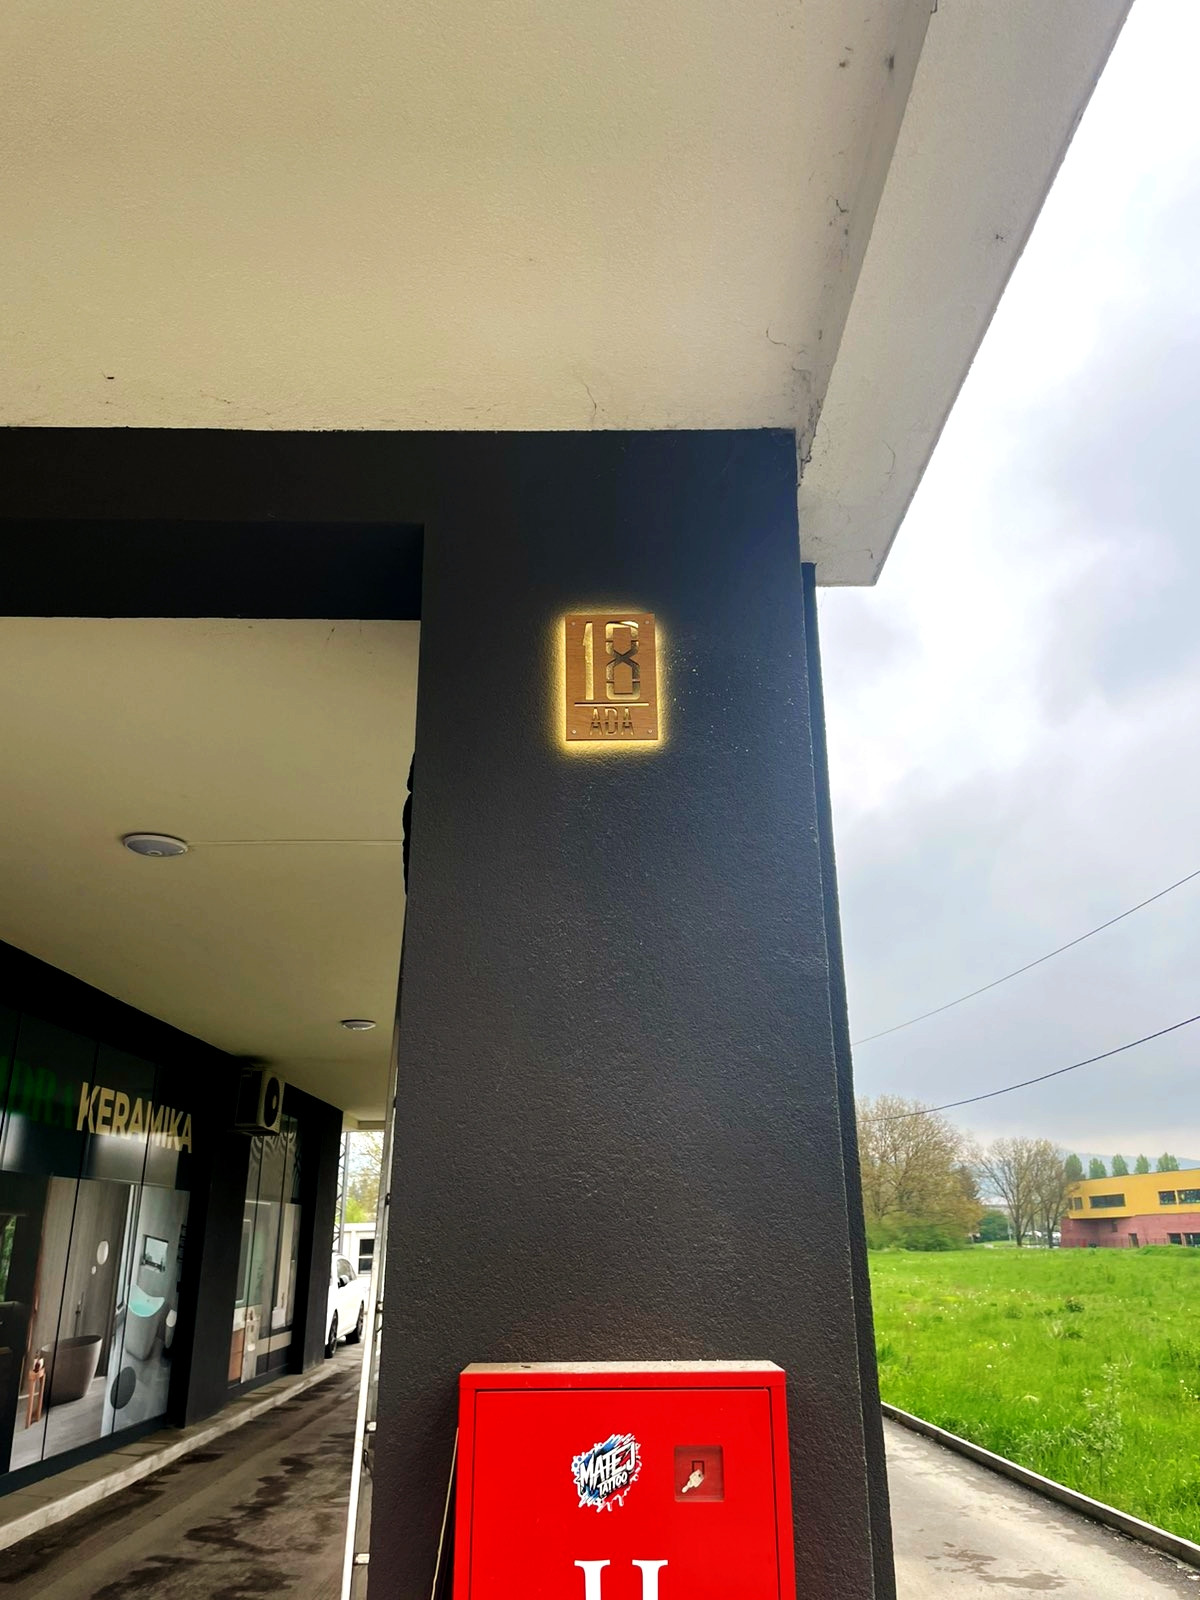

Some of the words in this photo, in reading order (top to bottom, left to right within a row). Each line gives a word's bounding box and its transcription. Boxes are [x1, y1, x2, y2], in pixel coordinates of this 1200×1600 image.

[582, 620, 641, 700] 18
[589, 706, 634, 736] ADA
[76, 1081, 193, 1153] KERAMIKA
[579, 1441, 636, 1491] MATEJ
[597, 1471, 628, 1496] TATTOO
